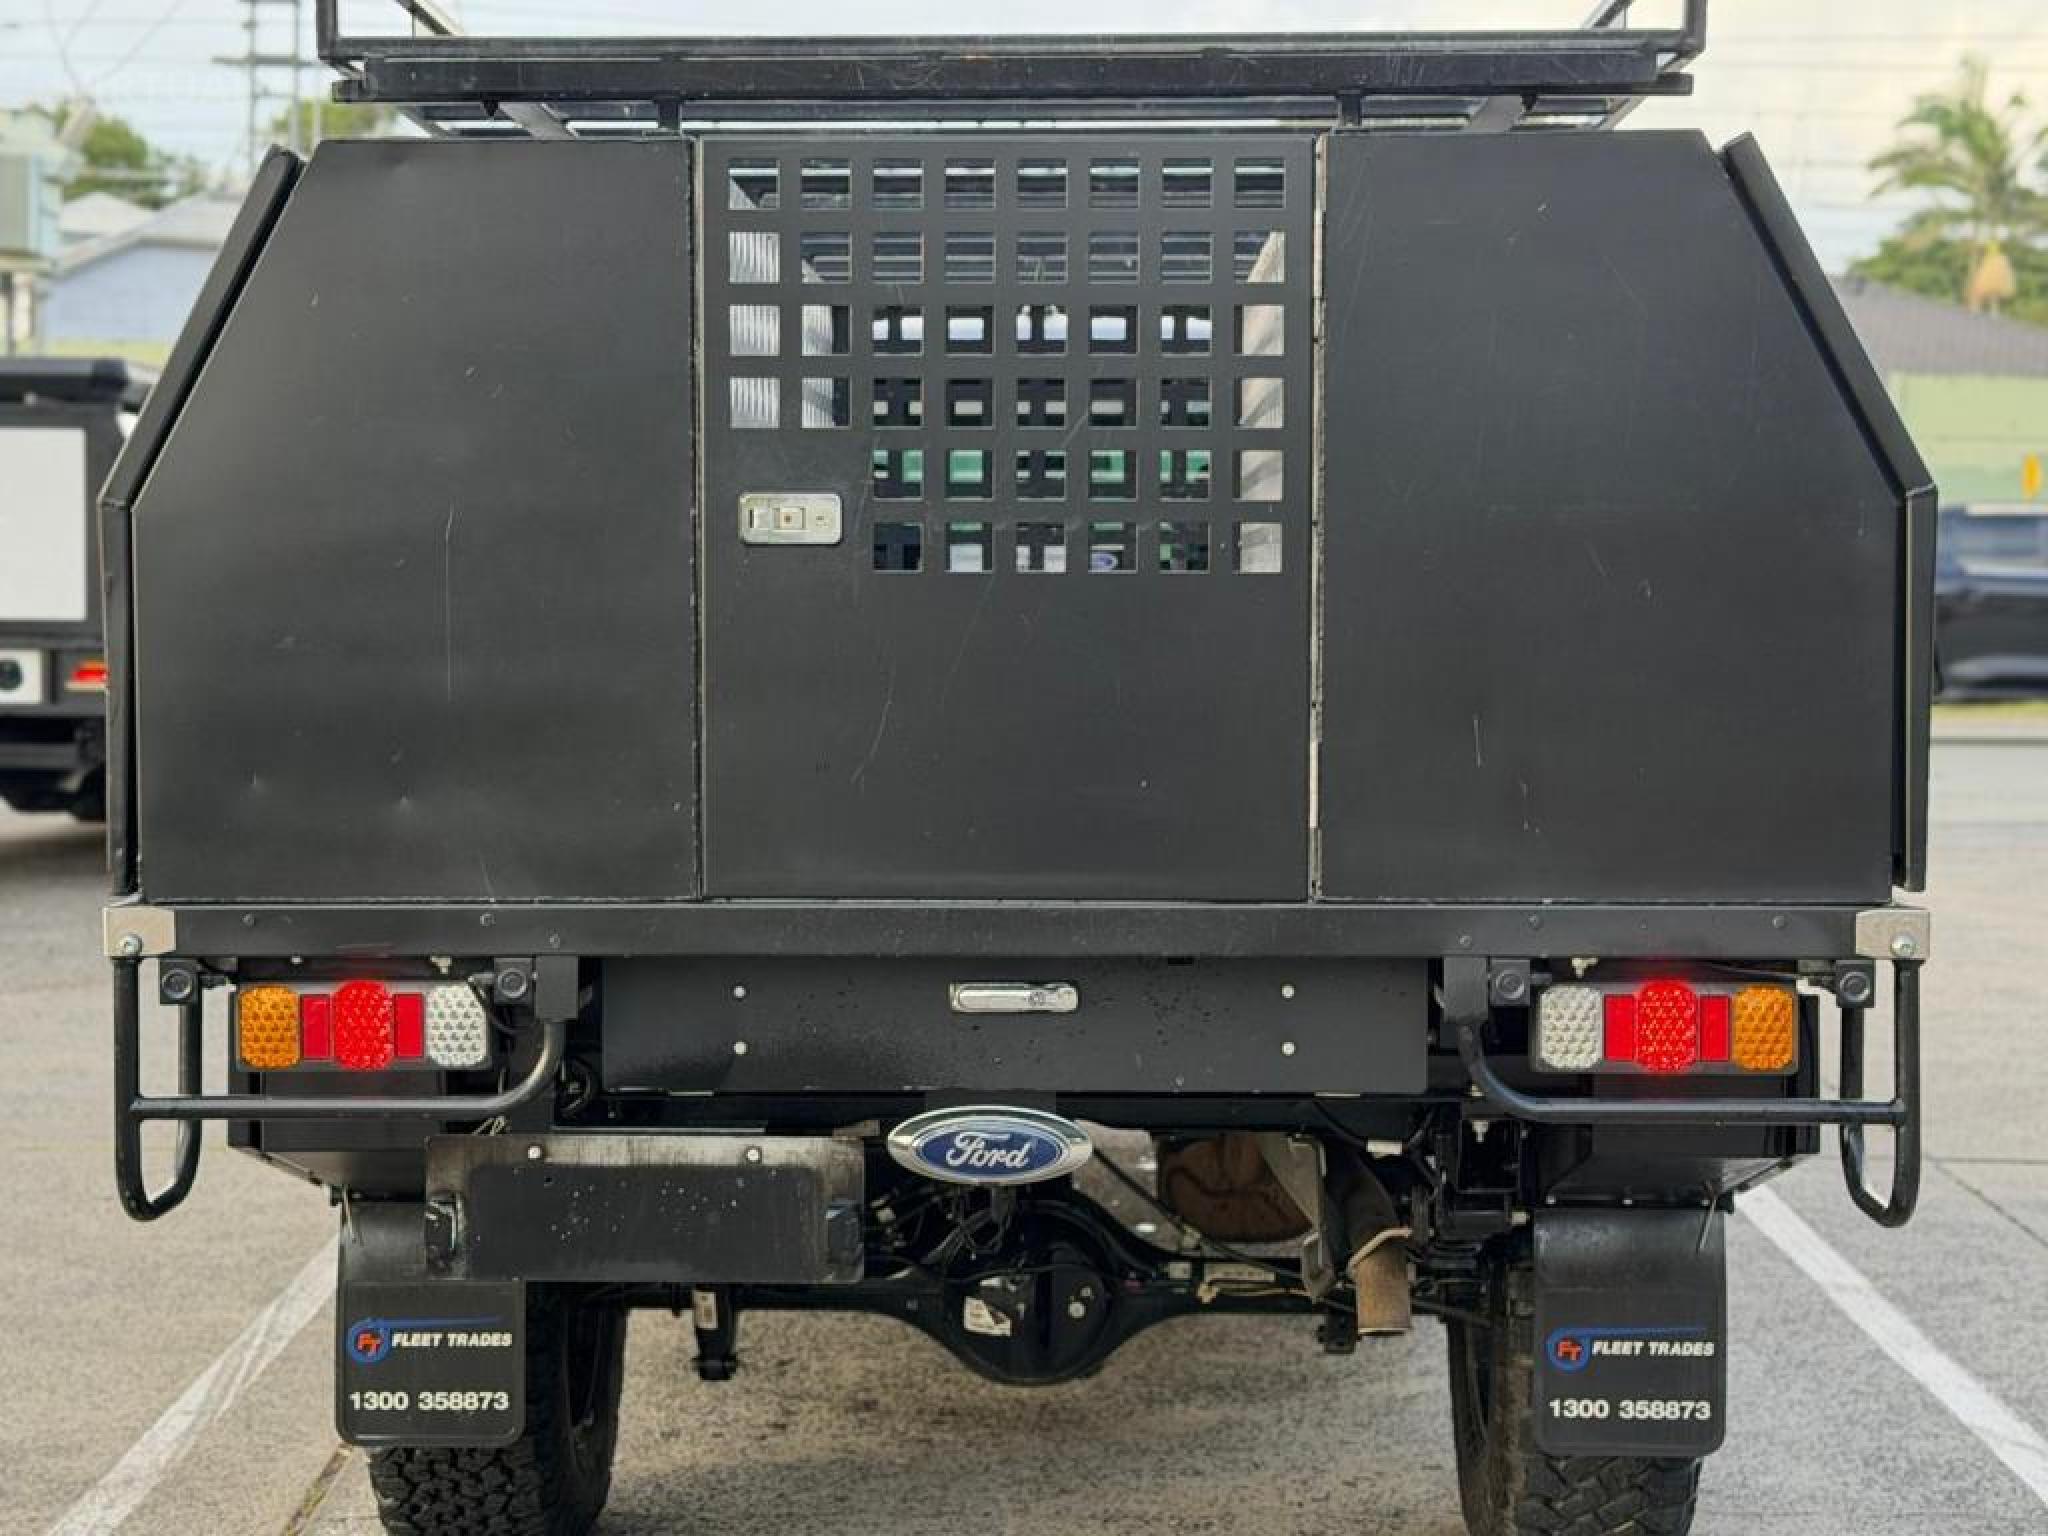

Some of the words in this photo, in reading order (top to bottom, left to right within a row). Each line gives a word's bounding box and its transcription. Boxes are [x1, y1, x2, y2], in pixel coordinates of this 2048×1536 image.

[946, 1132, 1032, 1168] Ford
[392, 1332, 443, 1347] FLEET
[448, 1332, 513, 1347] TRADES
[1592, 1340, 1645, 1356] FLEET
[1649, 1341, 1715, 1357] TRADES
[350, 1391, 409, 1411] 1300
[418, 1391, 510, 1411] 358873
[1549, 1398, 1610, 1419] 1300
